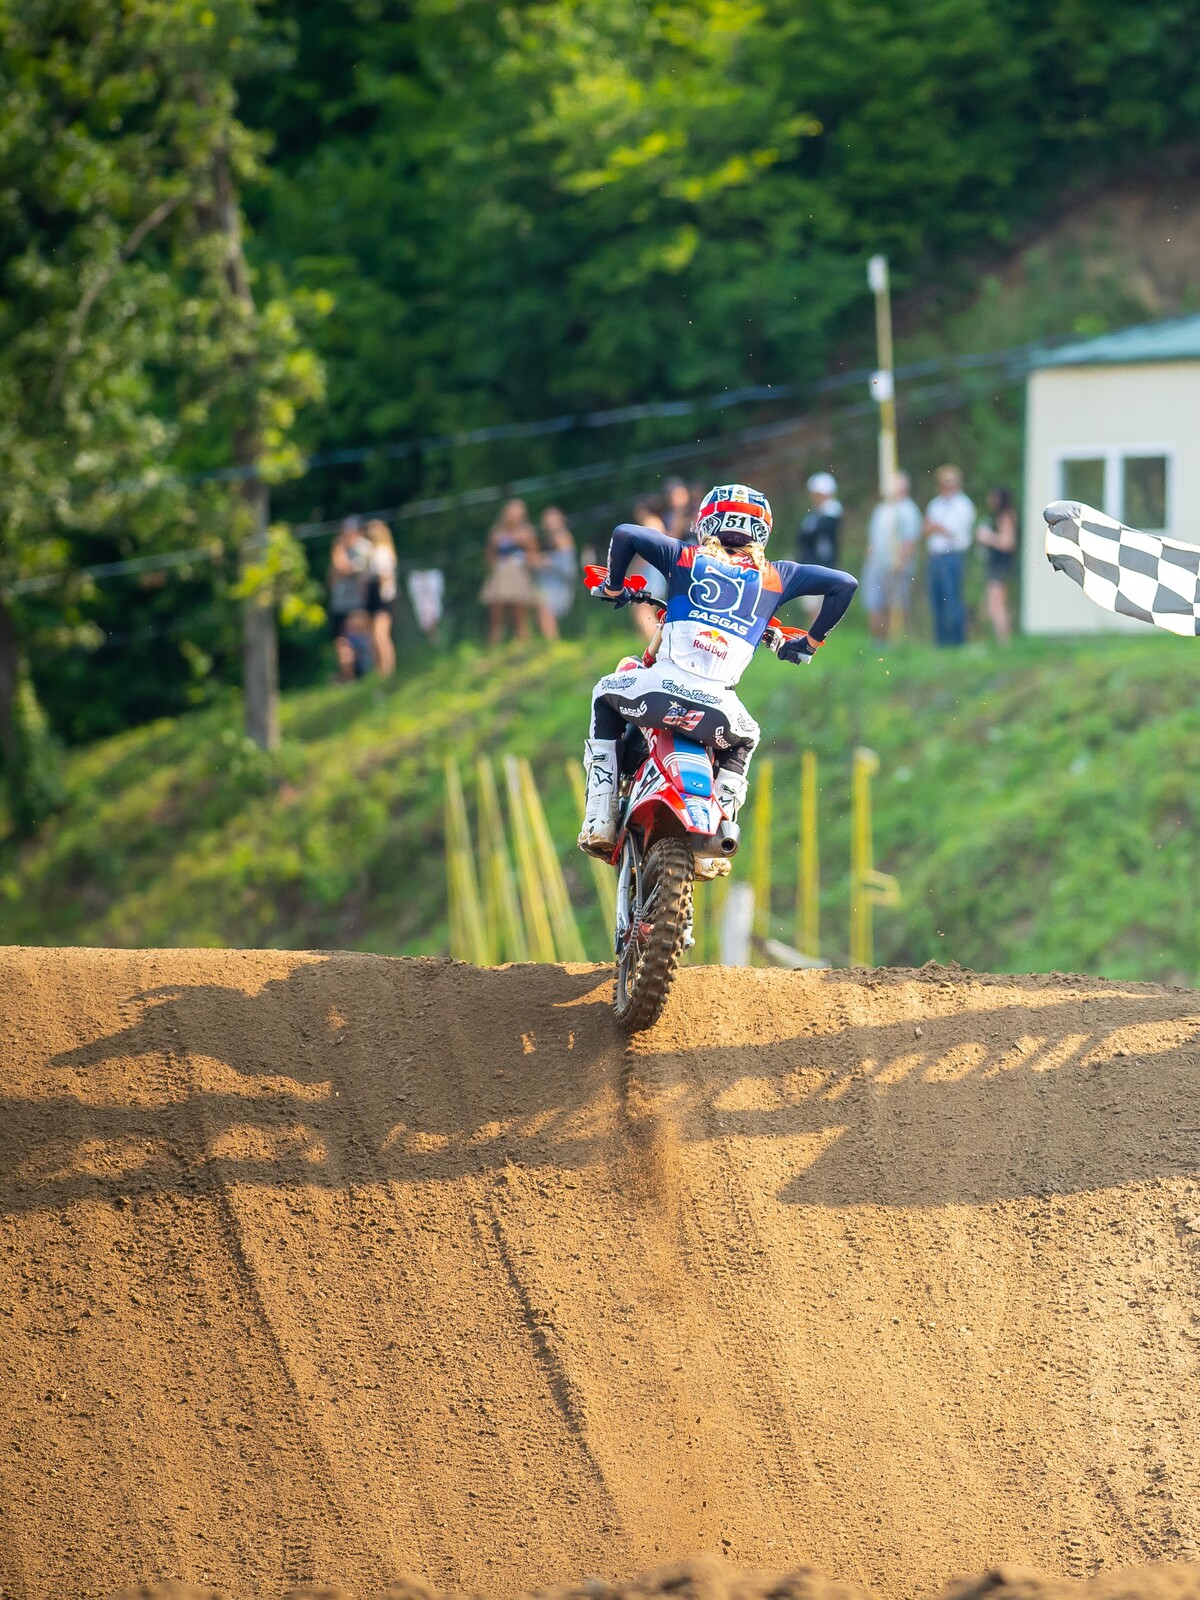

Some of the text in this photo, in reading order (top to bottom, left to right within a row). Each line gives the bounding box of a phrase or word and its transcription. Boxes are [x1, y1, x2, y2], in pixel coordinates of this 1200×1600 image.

[725, 514, 747, 529] 51
[687, 553, 763, 626] 51
[688, 609, 749, 636] GASGAS
[693, 638, 728, 660] Red Bull
